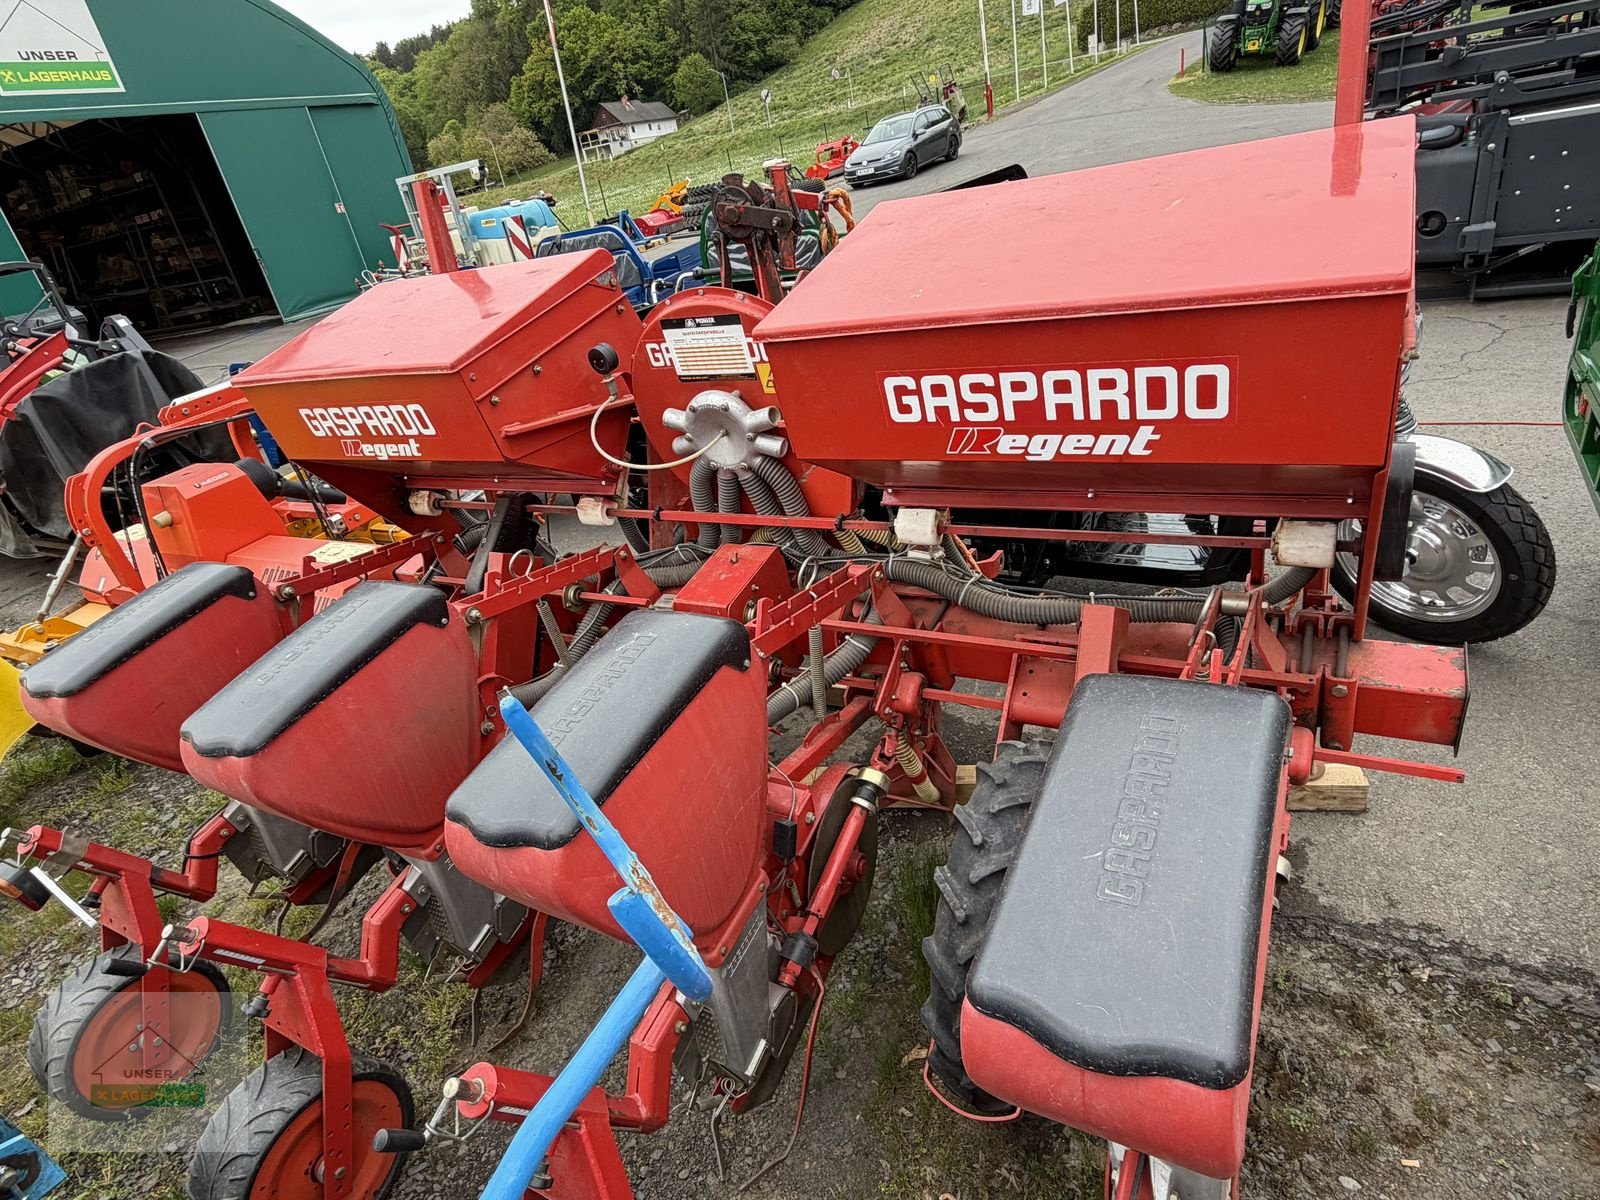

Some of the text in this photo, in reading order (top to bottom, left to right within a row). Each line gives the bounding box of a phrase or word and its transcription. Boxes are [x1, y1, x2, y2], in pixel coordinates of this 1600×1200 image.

[17, 50, 78, 61] UNSER
[17, 69, 112, 83] LAGERHAUS
[882, 363, 1231, 423] GASPARDO
[298, 403, 437, 437] GASPARDO
[340, 438, 422, 460] Regent
[945, 425, 1162, 461] Regent
[1095, 713, 1186, 908] GASPARDO
